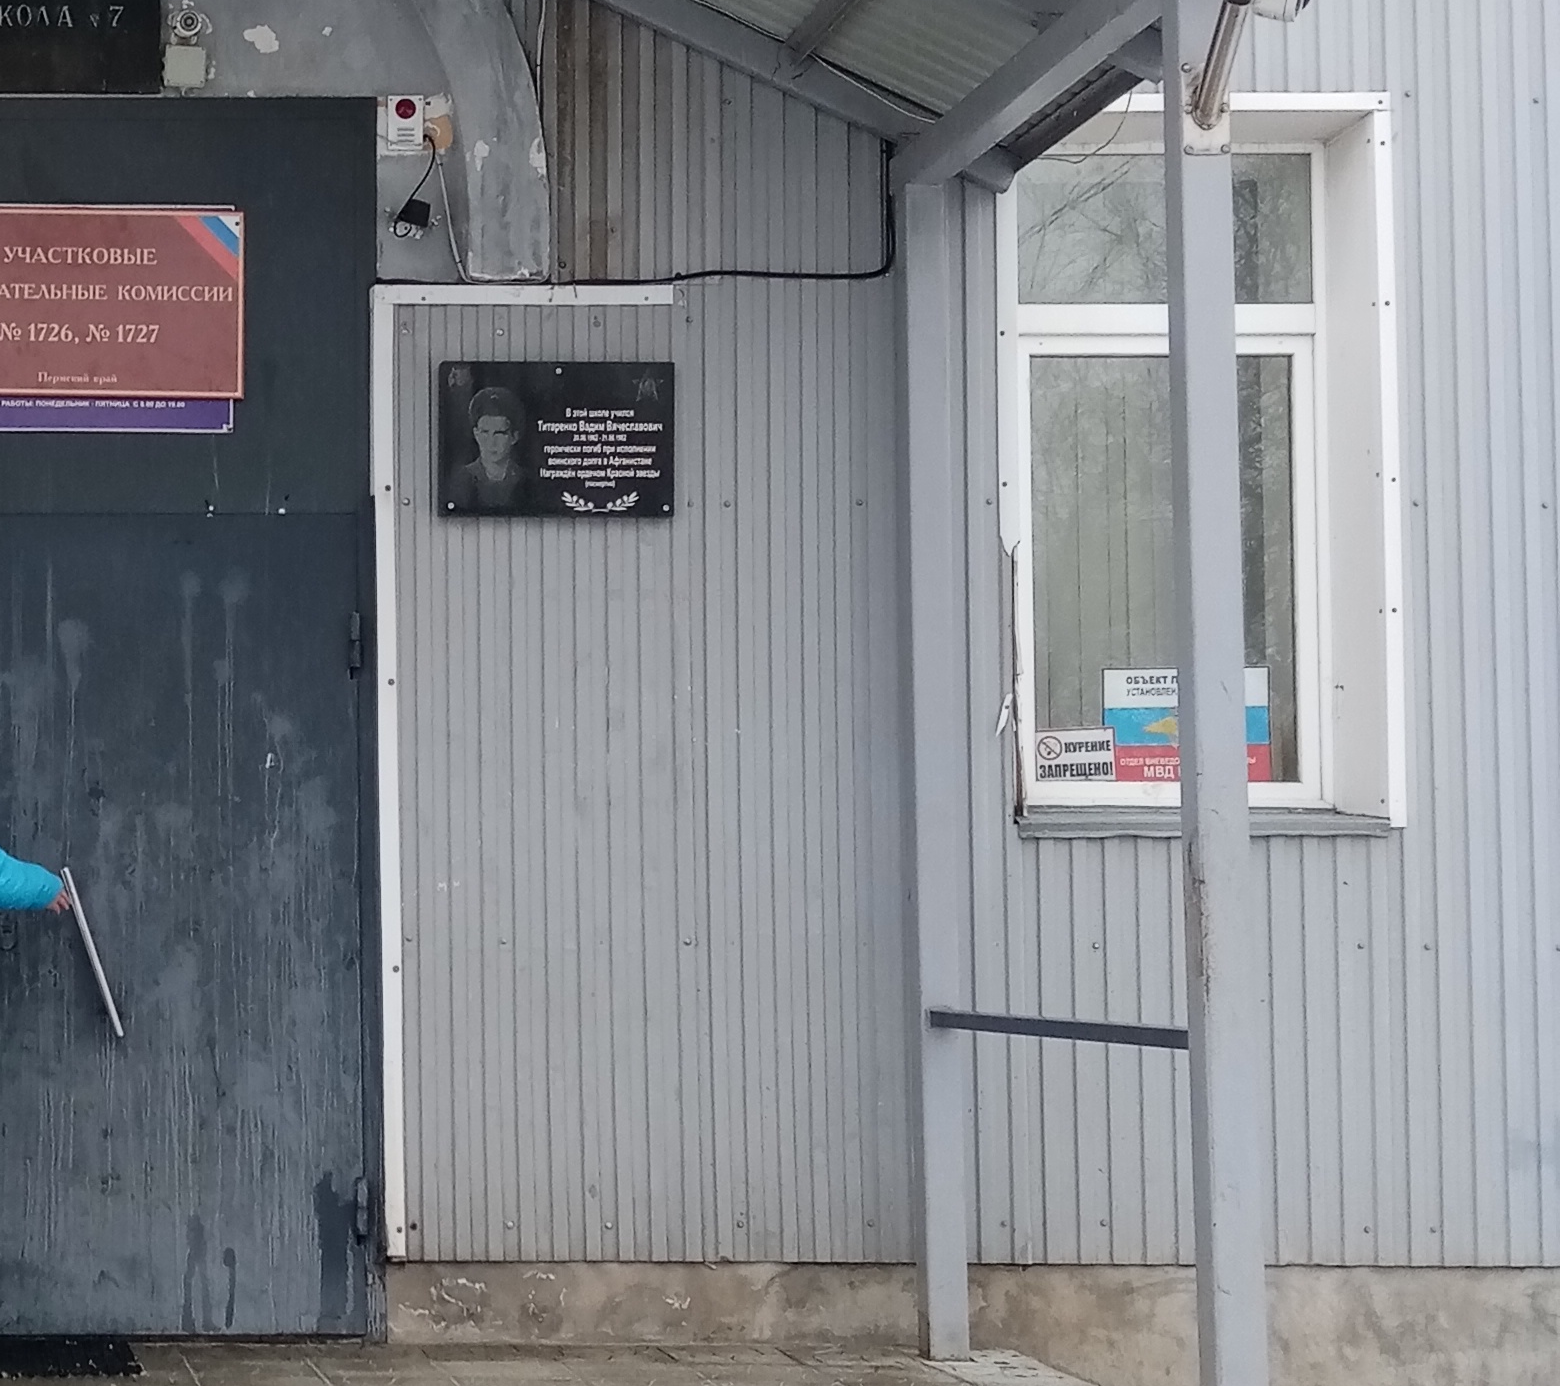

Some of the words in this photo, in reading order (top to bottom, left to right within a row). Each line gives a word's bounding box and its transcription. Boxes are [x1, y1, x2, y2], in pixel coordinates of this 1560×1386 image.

[108, 5, 125, 28] 7
[3, 246, 158, 266] УЧАСТКОВЫЕ
[117, 284, 234, 303] КОМИССИИ
[28, 323, 80, 345] 1726,
[85, 324, 110, 343] №
[117, 324, 160, 344] 1727
[38, 371, 90, 384] Пермский
[93, 374, 118, 385] край
[537, 420, 577, 434] Титаренко
[579, 420, 605, 433] Вадим
[606, 420, 663, 432] Вячеславович
[1126, 676, 1168, 685] ОБЪЕКТ
[1064, 740, 1112, 753] КУРЕНИЕ
[1039, 762, 1114, 778] ЗАПРЕЩЕНО!
[1143, 766, 1175, 778] МВД
